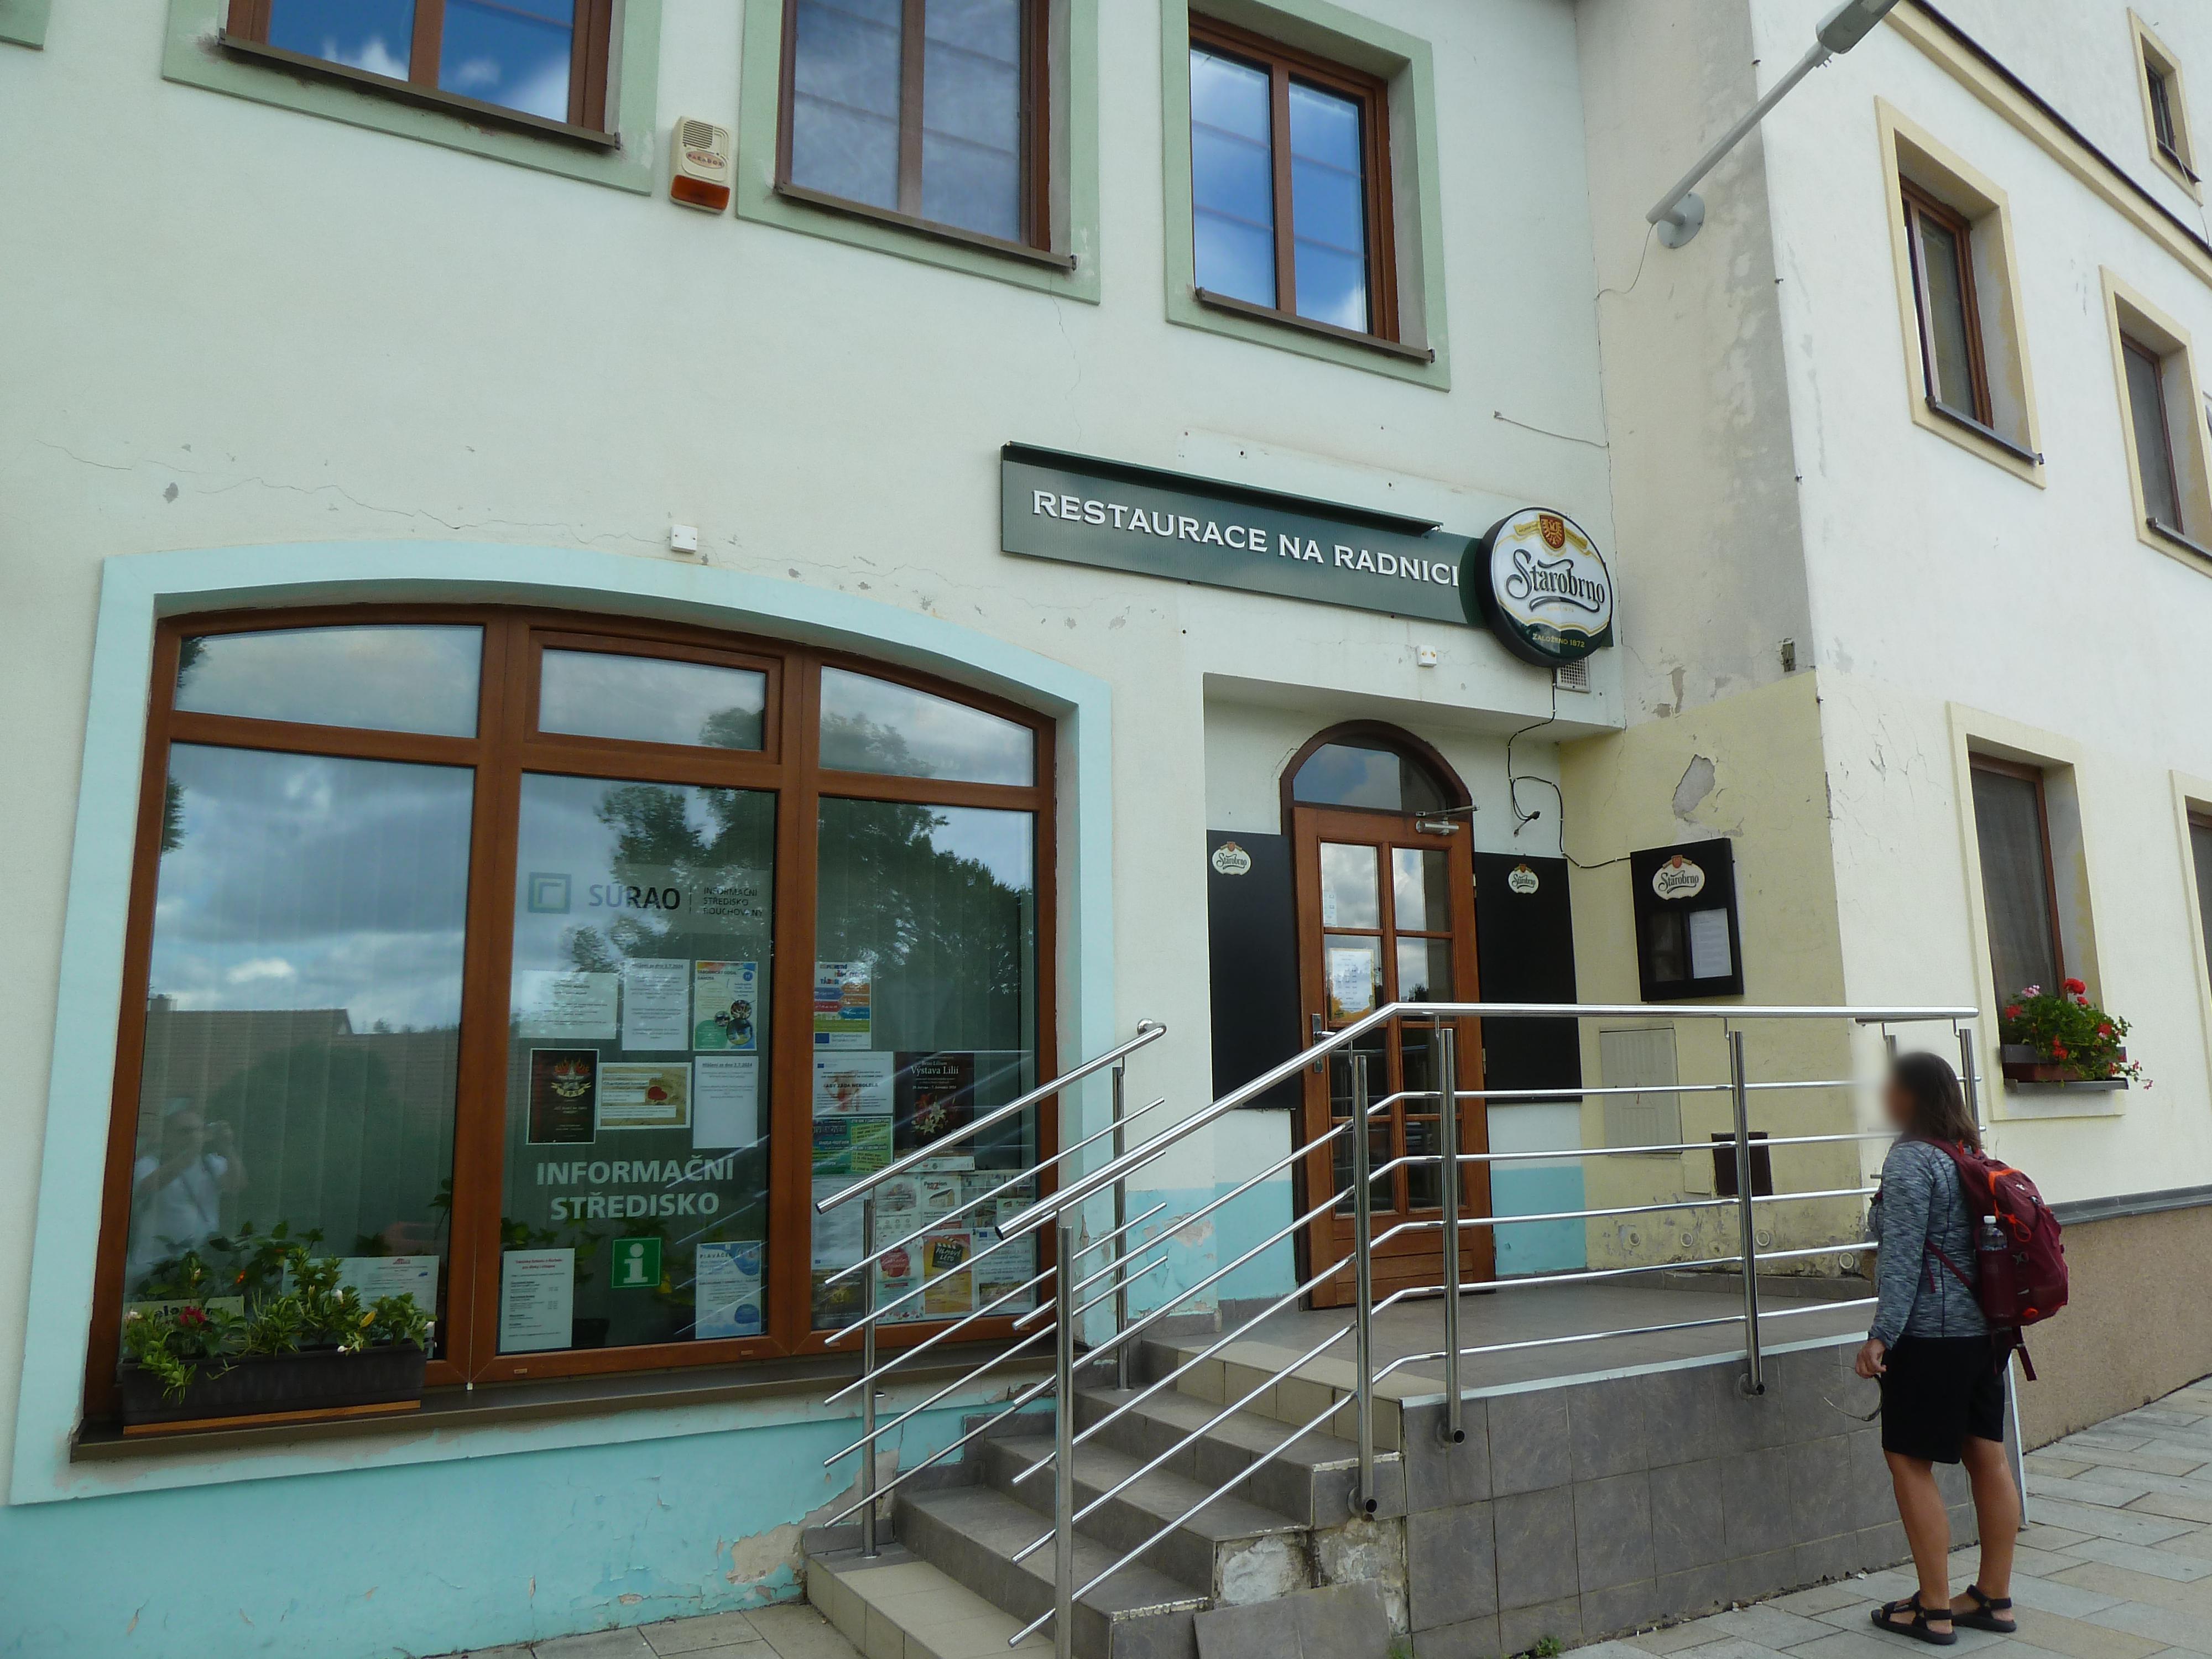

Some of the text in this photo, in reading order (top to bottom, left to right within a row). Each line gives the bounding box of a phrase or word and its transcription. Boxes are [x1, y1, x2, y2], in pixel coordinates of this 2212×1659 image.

[1032, 489, 1459, 587] RESTAURACE NA RADNICI
[1506, 548, 1605, 612] Starobrno
[1570, 639, 1585, 648] 1872
[1658, 870, 1699, 894] Starobrno
[910, 1066, 941, 1077] Výstava
[536, 1155, 734, 1186] INFORMAČNÍ
[550, 1192, 719, 1221] STŘEDISKO
